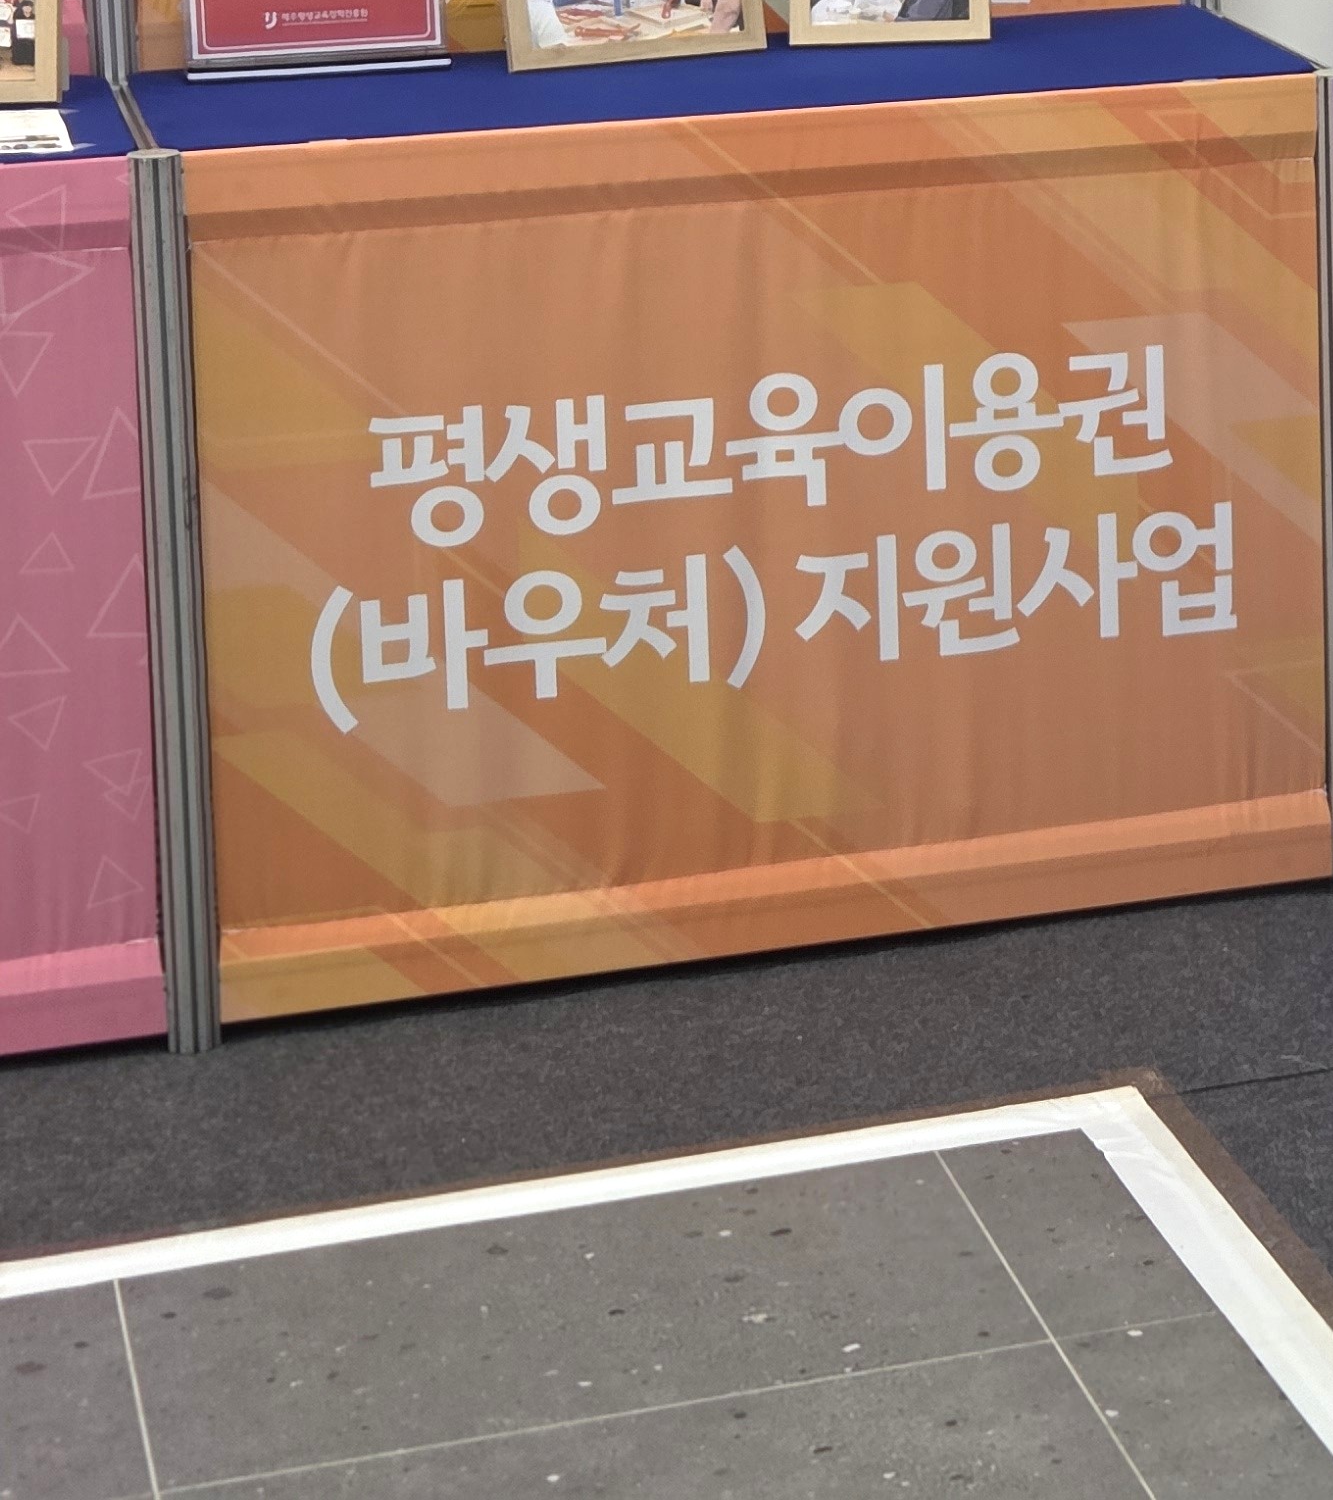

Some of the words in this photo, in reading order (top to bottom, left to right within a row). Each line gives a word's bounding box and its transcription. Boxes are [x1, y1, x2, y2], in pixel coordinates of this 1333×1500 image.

[369, 344, 1172, 548] 평생교육이용권
[310, 545, 767, 735] (바우처)
[795, 501, 1239, 662] 지원사업
